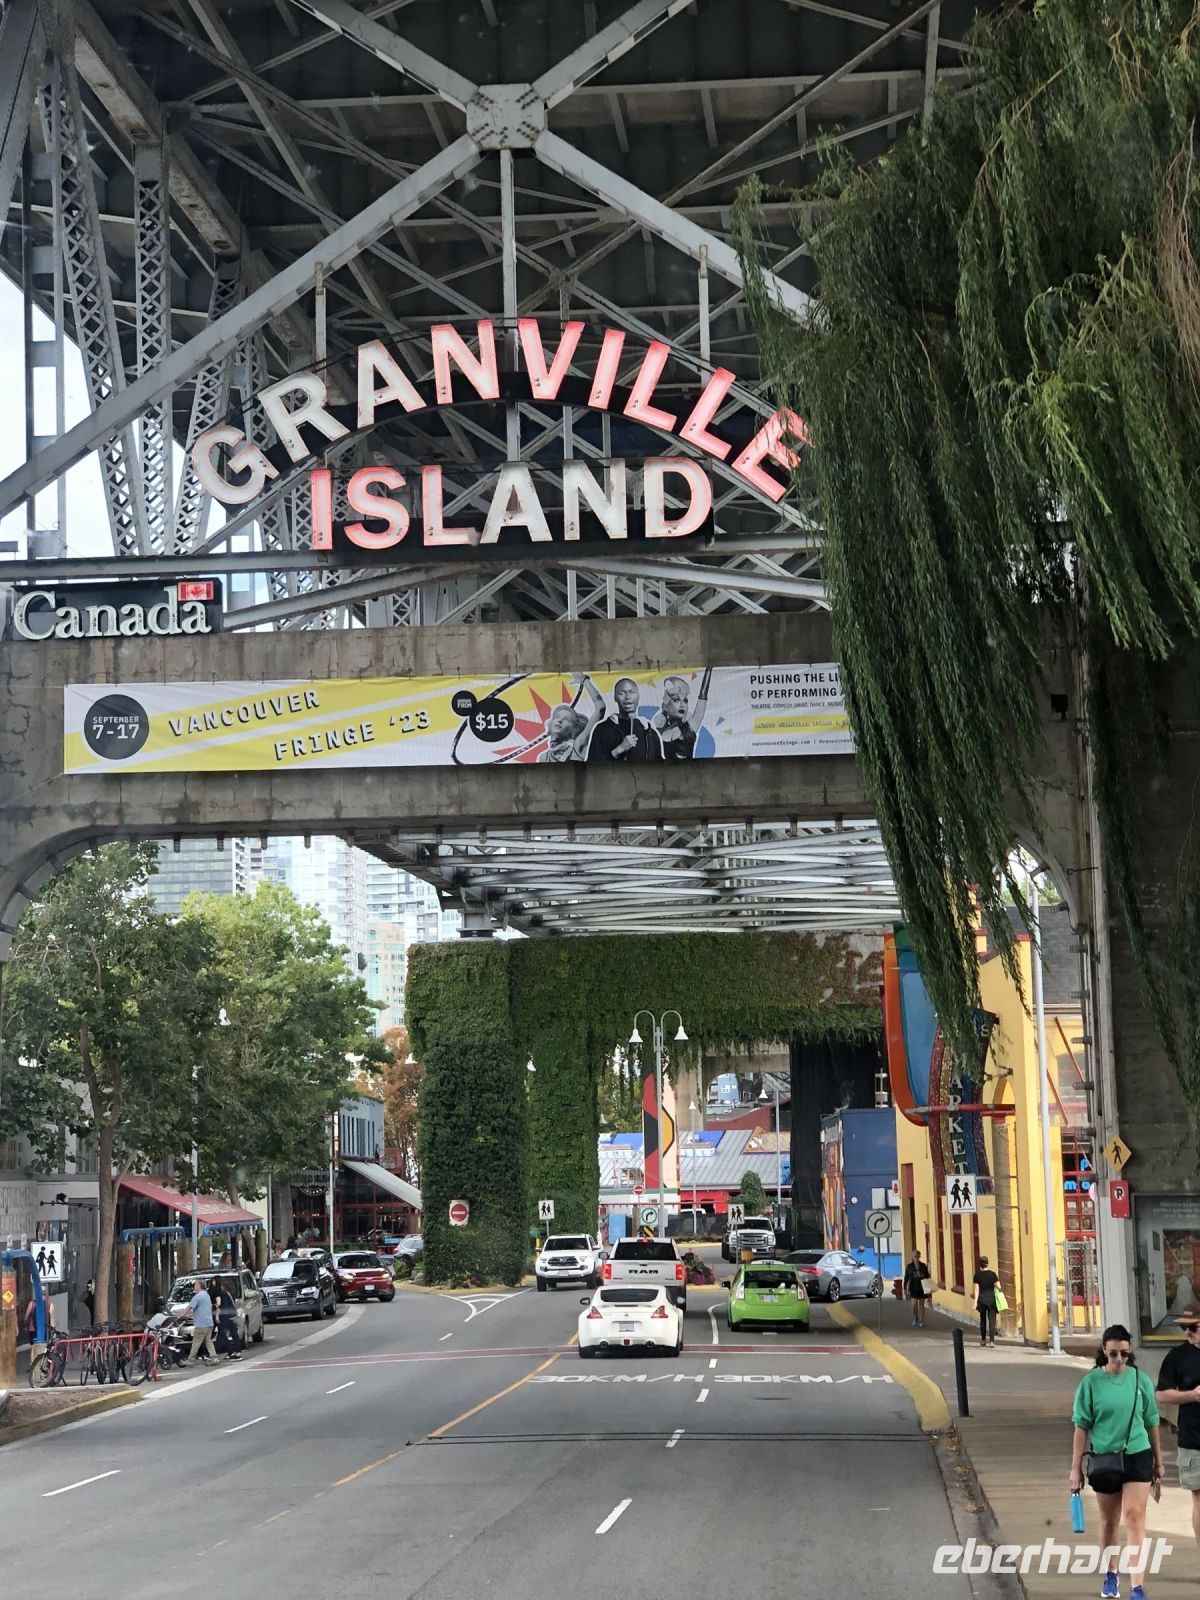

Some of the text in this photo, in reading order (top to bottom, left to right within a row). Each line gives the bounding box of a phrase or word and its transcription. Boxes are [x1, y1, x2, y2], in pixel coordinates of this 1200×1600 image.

[192, 318, 815, 504] GRANVILLE
[311, 456, 712, 549] ISLAND
[14, 586, 212, 640] Canada
[750, 673, 801, 685] PUSHING
[804, 672, 825, 683] THE
[750, 689, 764, 699] OF
[767, 687, 837, 699] PERFORMING
[92, 715, 140, 724] SEPTEMBER
[168, 689, 320, 737] VANCOUVER
[475, 711, 509, 731] $15
[92, 723, 140, 740] 7-17
[274, 722, 375, 760] FRINGE
[713, 1373, 894, 1385] 30KM/H
